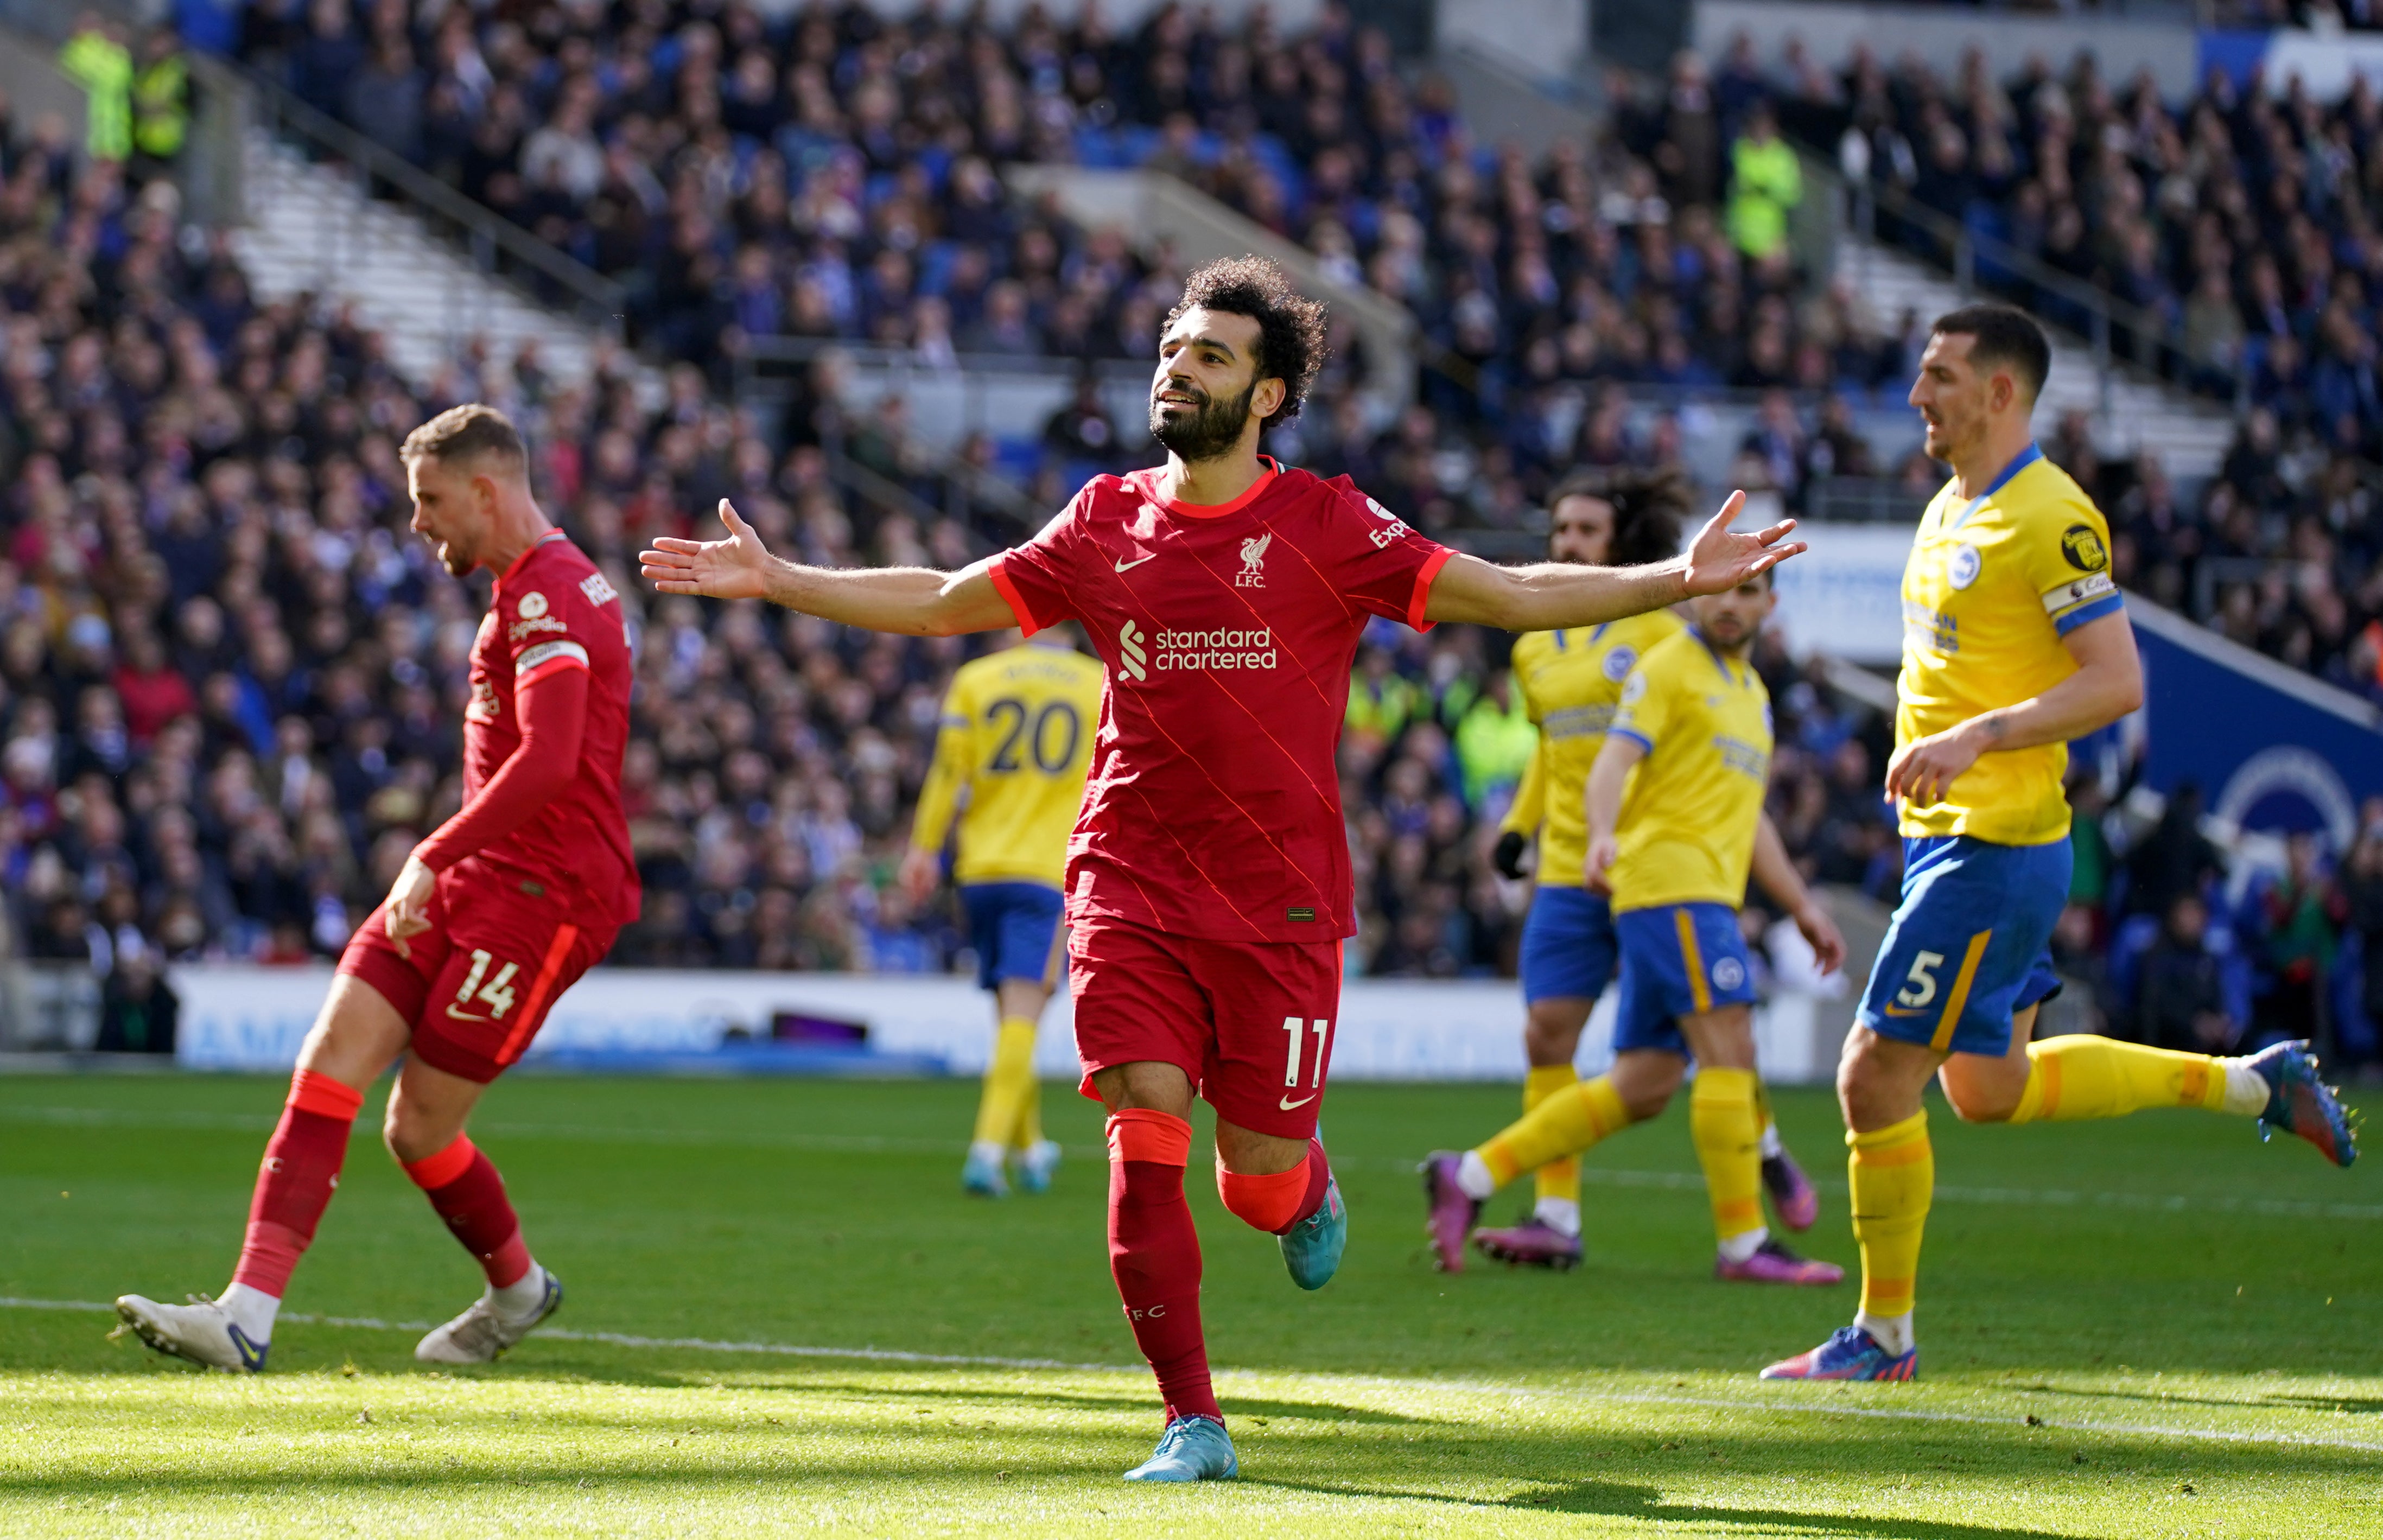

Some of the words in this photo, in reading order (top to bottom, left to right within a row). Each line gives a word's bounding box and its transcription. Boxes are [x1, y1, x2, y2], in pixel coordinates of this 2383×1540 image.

[1235, 575, 1266, 588] L.F.C.
[1155, 648, 1276, 670] chartered
[1156, 627, 1270, 650] standard
[987, 699, 1079, 773] 20
[456, 948, 520, 1020] 14
[1897, 950, 1944, 1007] 5
[1282, 1017, 1328, 1089] 11
